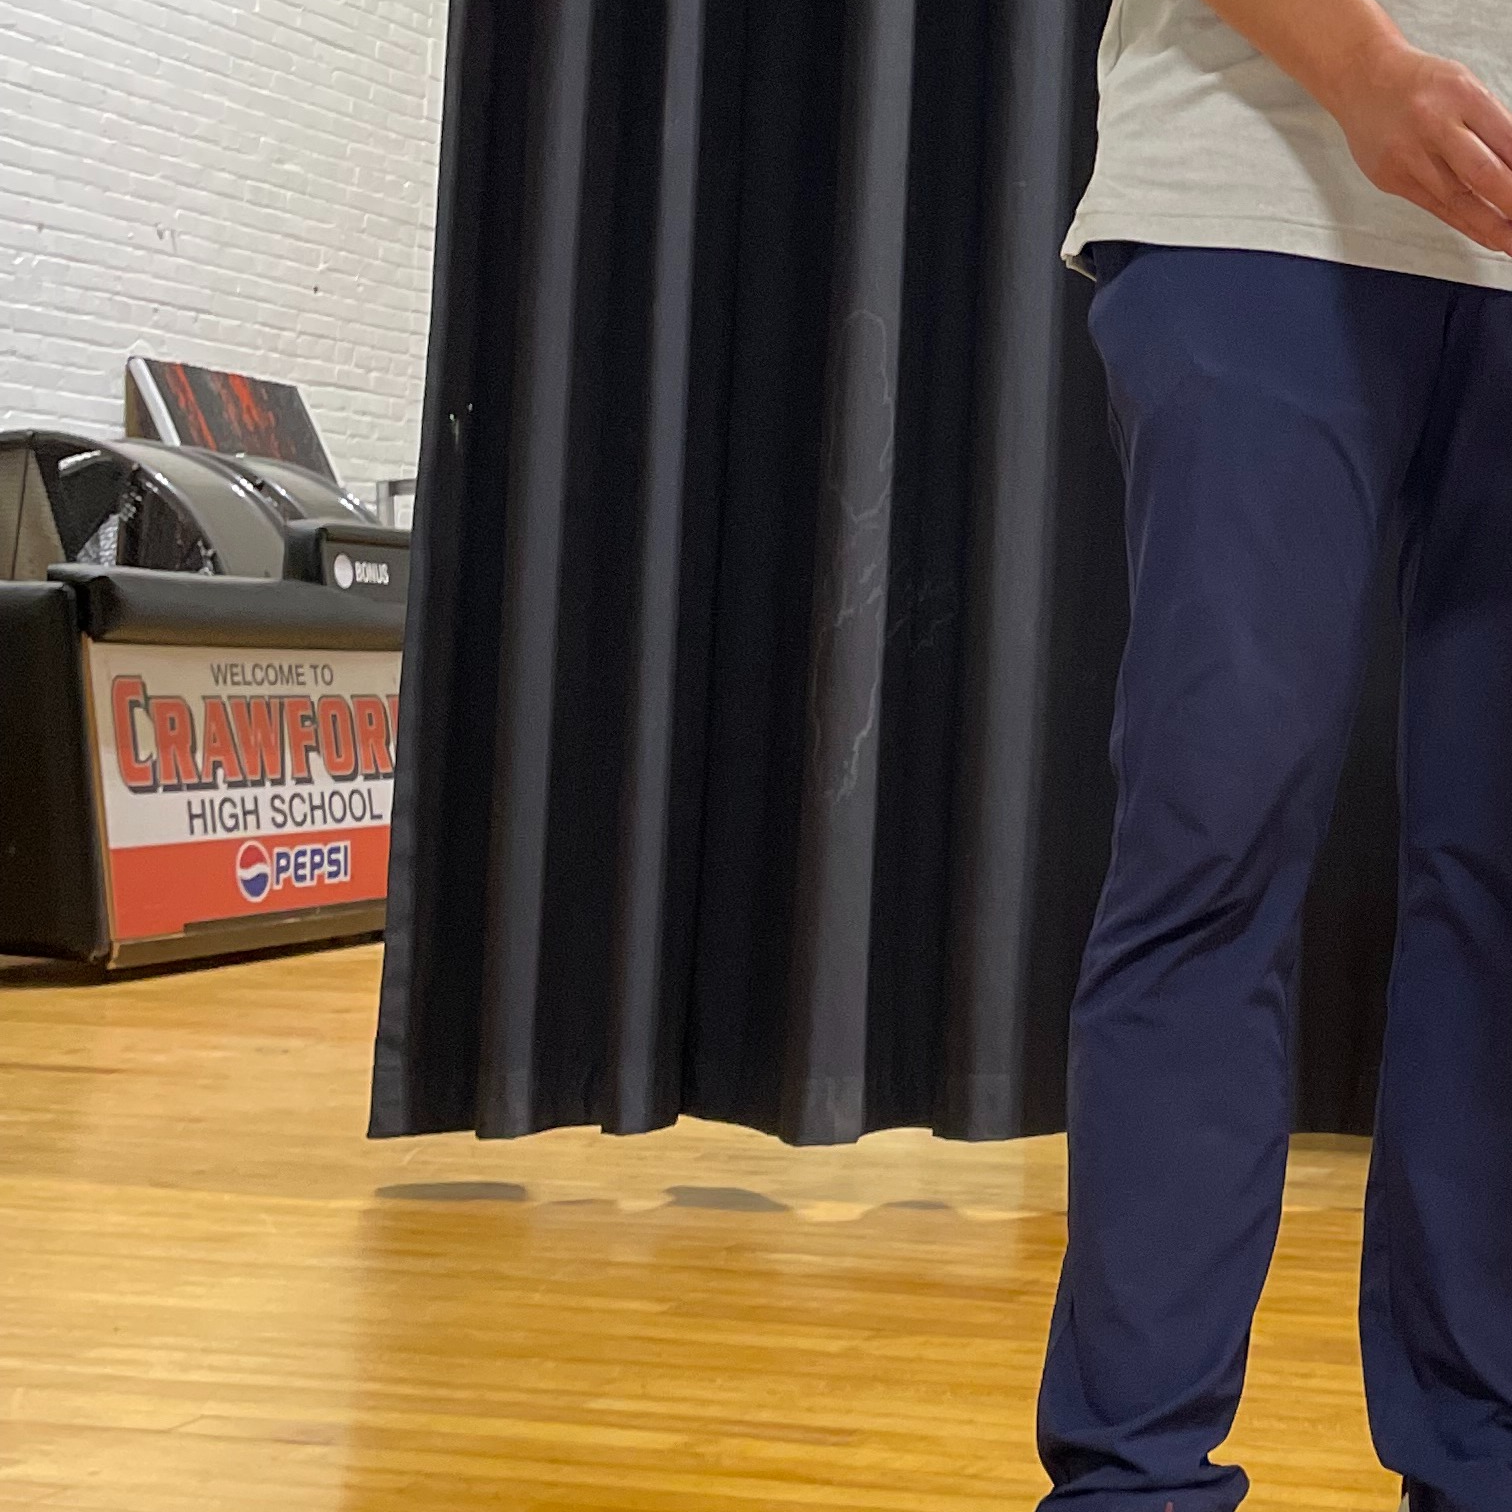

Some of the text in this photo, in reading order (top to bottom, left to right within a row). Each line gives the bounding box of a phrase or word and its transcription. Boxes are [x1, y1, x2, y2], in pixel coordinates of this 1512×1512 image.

[210, 662, 334, 687] WELCOME TO
[187, 788, 383, 835] HIGH SCHOOL
[274, 841, 351, 889] PEPSI
